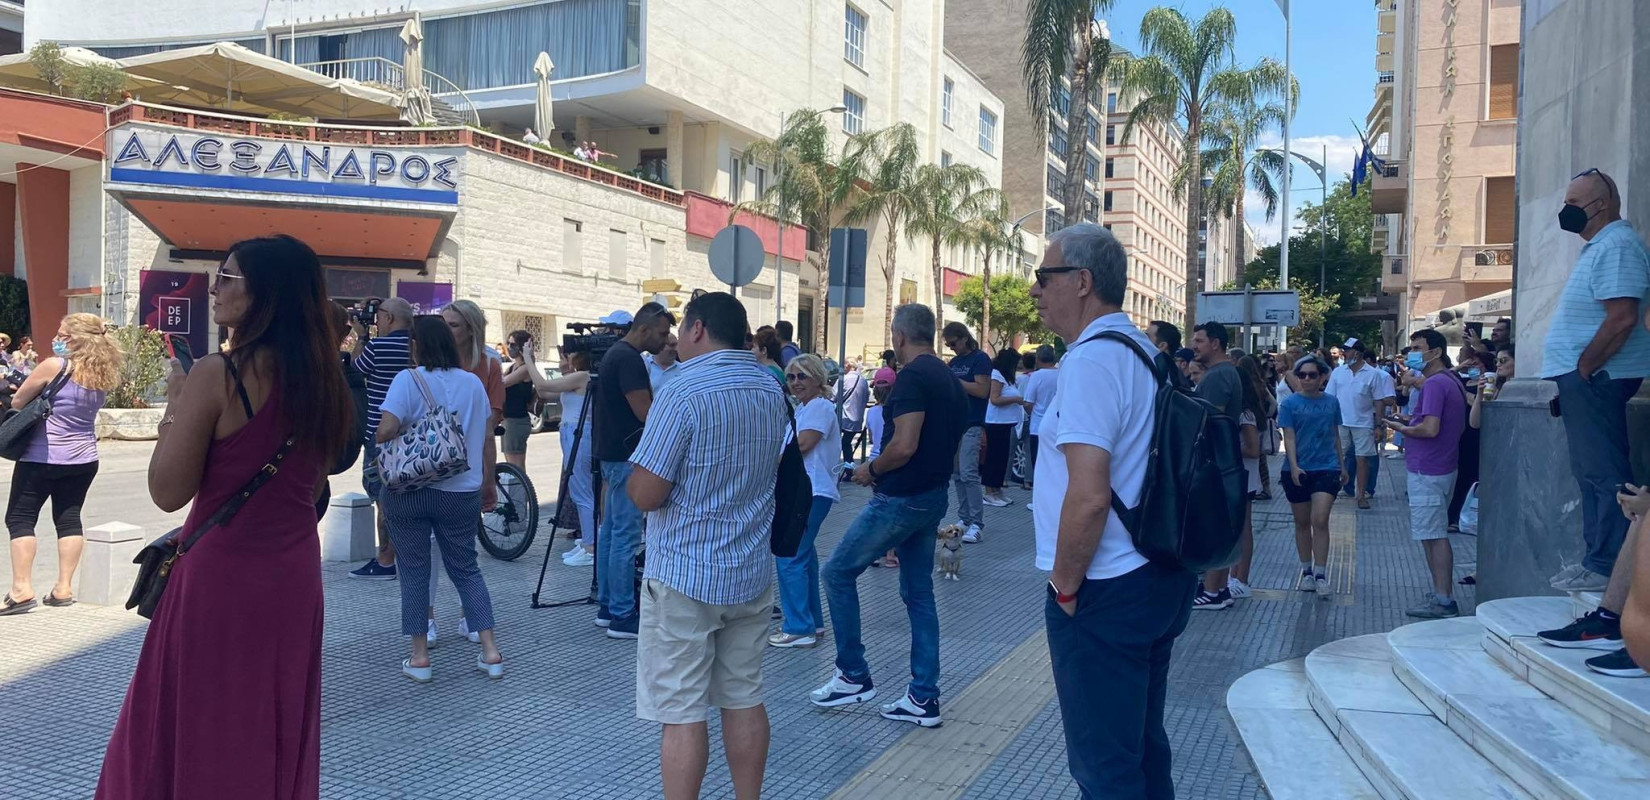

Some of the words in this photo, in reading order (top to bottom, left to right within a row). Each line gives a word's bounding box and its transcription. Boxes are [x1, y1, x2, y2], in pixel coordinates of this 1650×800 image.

[114, 132, 457, 189] ΑΛΕΞΑΝΔΡΟΣ
[1440, 115, 1455, 239] ΣΠΟΥΔΩΝ
[168, 305, 181, 315] DE
[168, 316, 181, 326] EP
